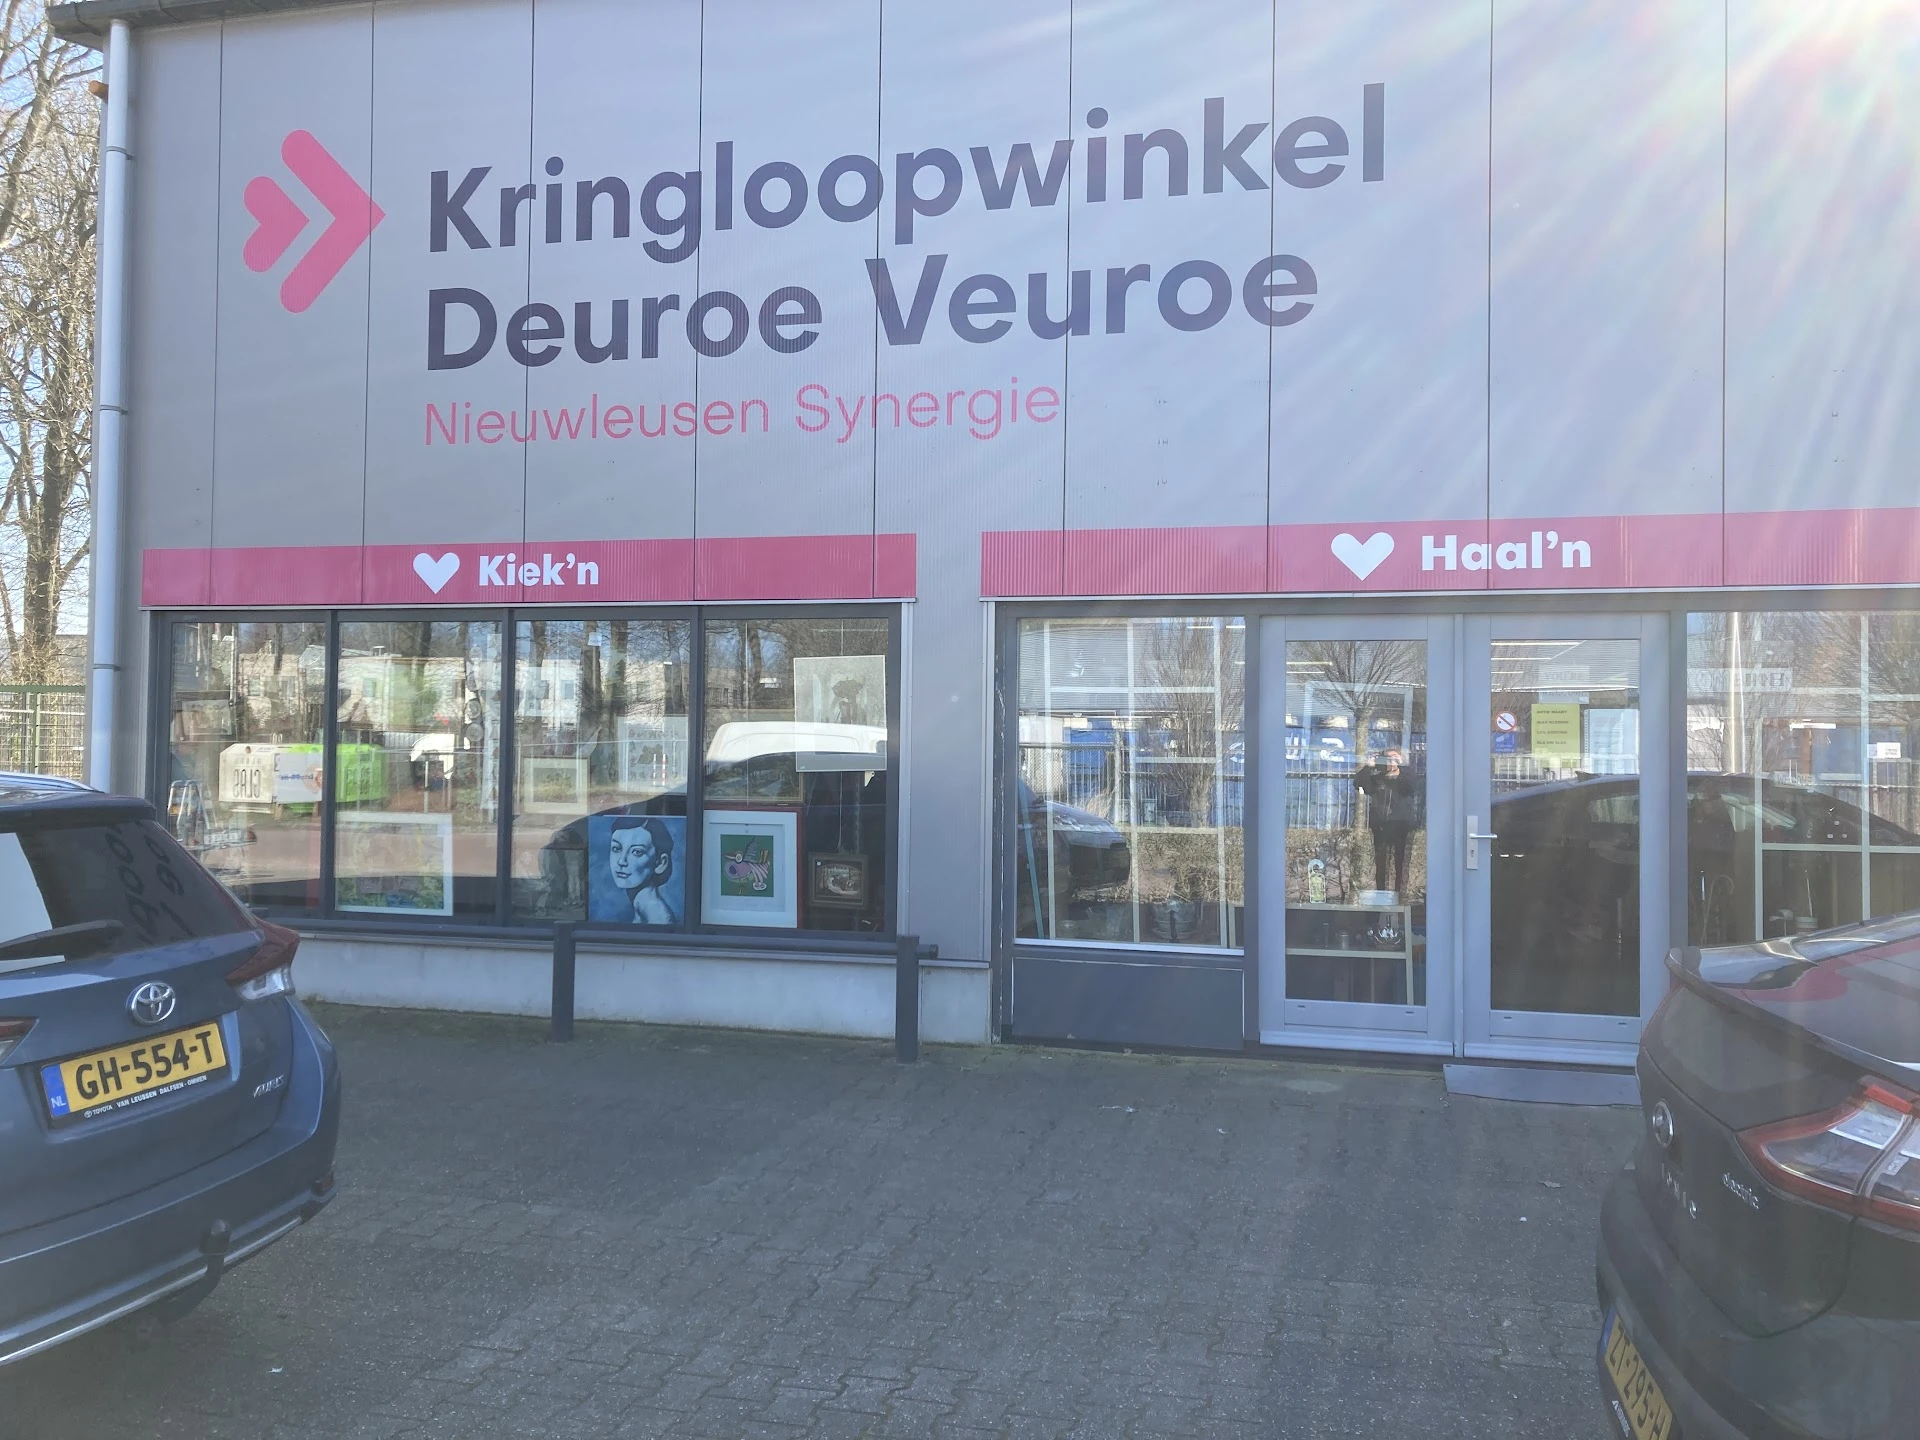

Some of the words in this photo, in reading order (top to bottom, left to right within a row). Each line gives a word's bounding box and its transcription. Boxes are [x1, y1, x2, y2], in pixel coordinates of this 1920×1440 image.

[430, 82, 1385, 263] Kringloopwinkel
[427, 286, 823, 371] Deuroe
[864, 253, 1318, 346] Veuroe
[424, 393, 769, 446] Nieuwleusen
[795, 376, 1060, 443] Synergie
[478, 552, 599, 586] Kiek'n
[1421, 530, 1592, 571] Haal'n
[75, 1030, 212, 1100] GH-554-T
[50, 1095, 67, 1108] NL
[92, 1104, 113, 1115] TOYOTA
[116, 1099, 130, 1108] VAN
[130, 1090, 157, 1104] LEUSSEN
[159, 1082, 184, 1095] DALFSEN
